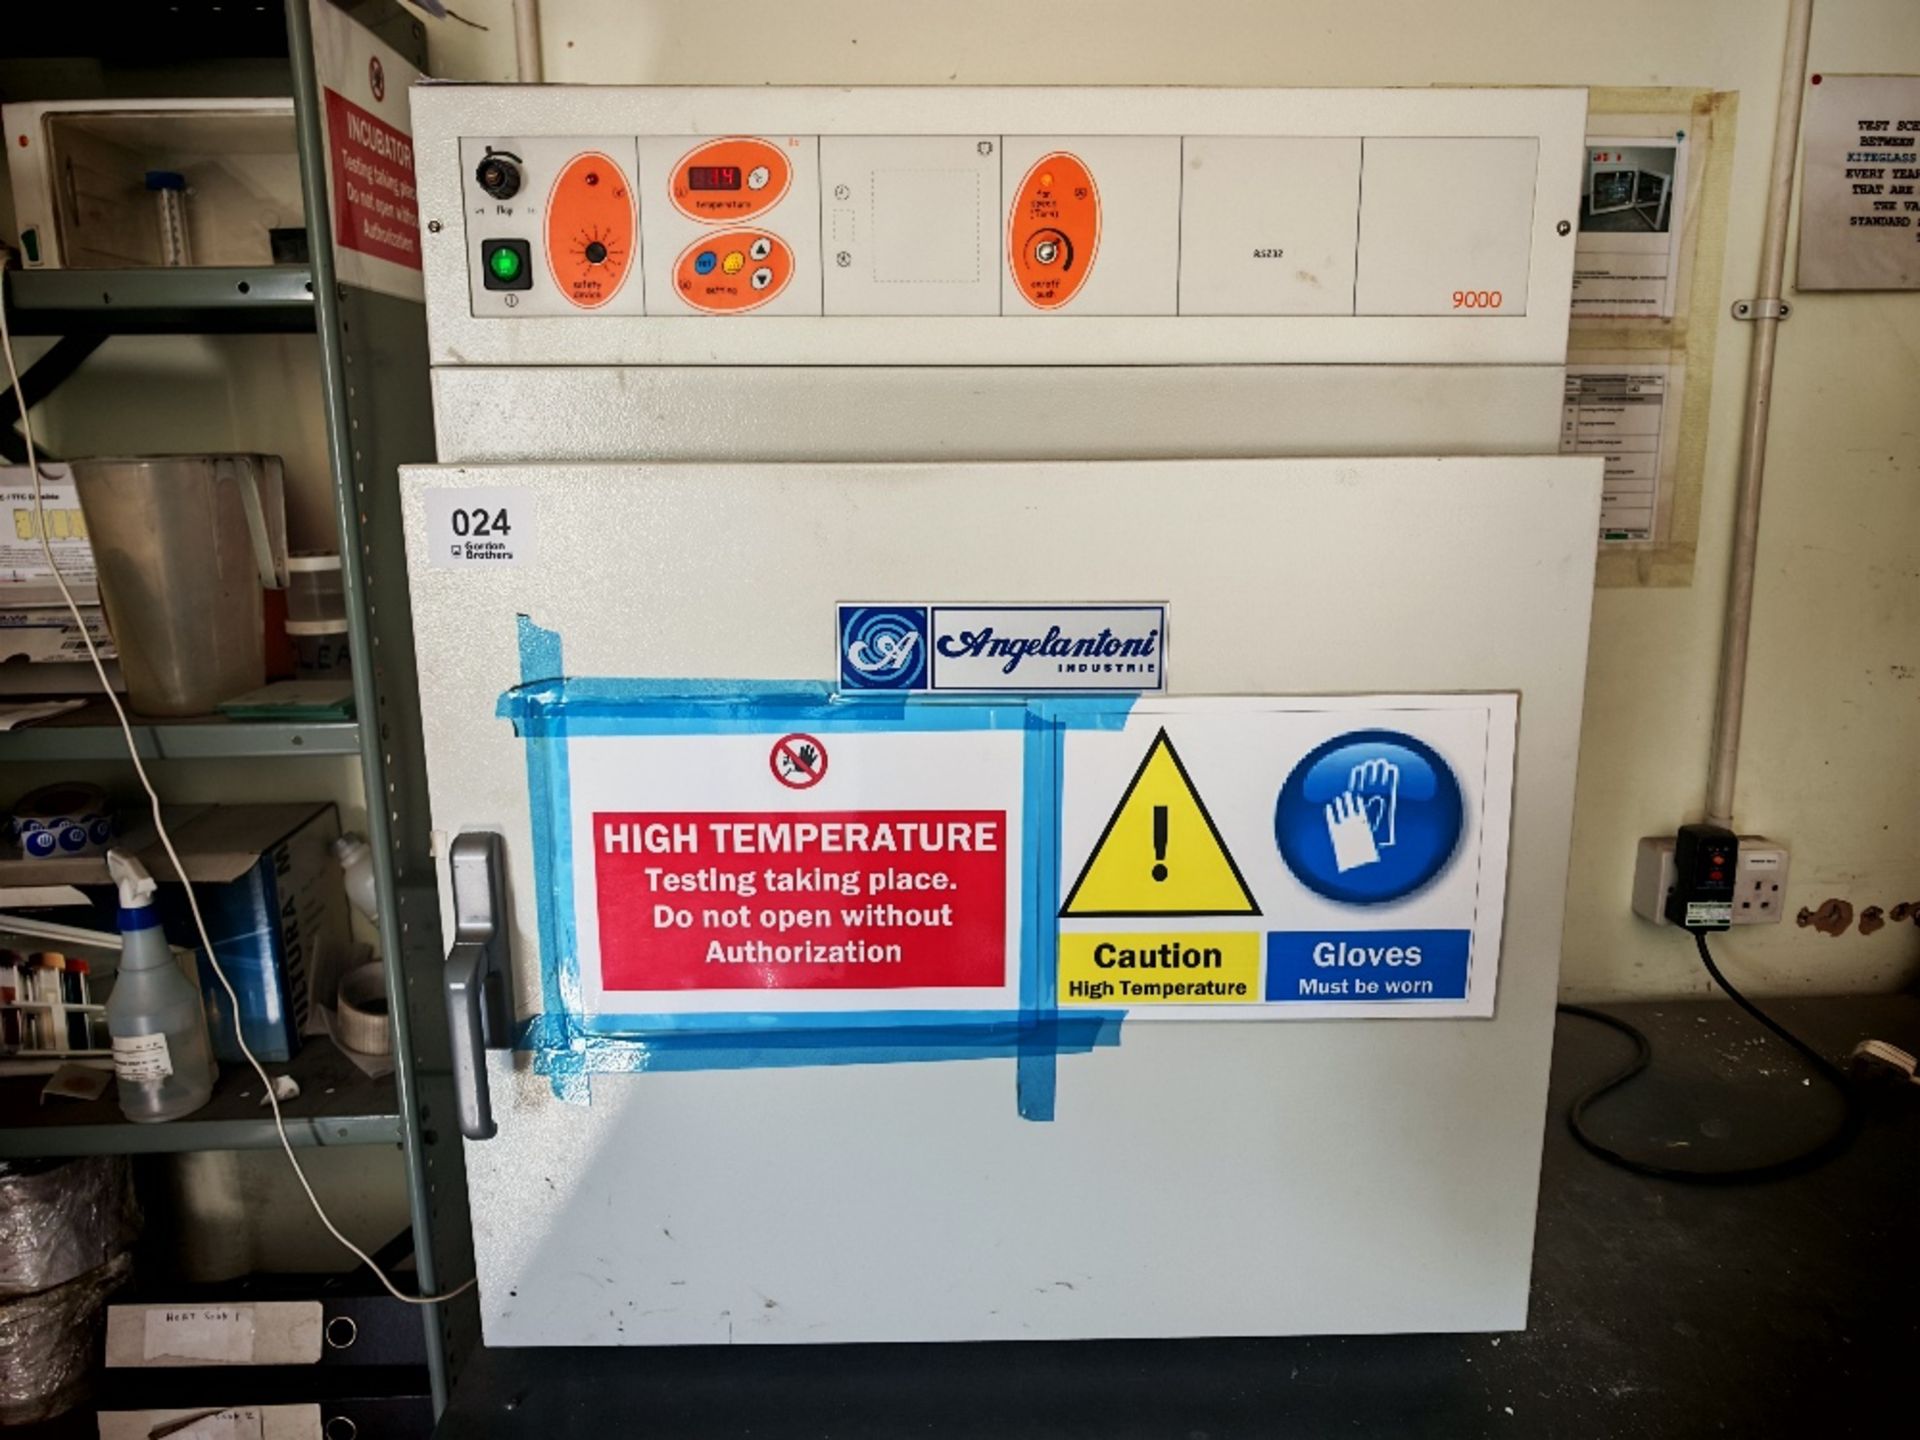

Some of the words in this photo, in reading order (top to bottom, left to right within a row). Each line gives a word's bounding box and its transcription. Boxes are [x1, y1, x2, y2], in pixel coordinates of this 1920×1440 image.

[1858, 120, 1890, 131] TEST
[347, 112, 412, 171] INCUBATOR
[1859, 136, 1915, 147] BETWEEN
[1847, 152, 1917, 163] KITEGLASS
[342, 148, 374, 186] Testing
[373, 164, 399, 197] taking
[1845, 168, 1885, 179] EVERY
[1852, 184, 1884, 195] THAT
[1889, 185, 1914, 195] ARE
[696, 200, 751, 211] temperature
[1850, 216, 1911, 227] STANDARD
[1453, 291, 1502, 308] 9000
[452, 508, 511, 536] 024
[465, 541, 506, 551] Gordon
[466, 550, 513, 560] Brothers
[937, 626, 1159, 675] Angelantoni
[1058, 663, 1155, 673] INDUSTRIE
[603, 823, 698, 854] HIGH
[709, 822, 998, 854] TEMPERATURE
[644, 867, 757, 896] Testing
[764, 867, 861, 896] taking
[869, 867, 958, 895] place.
[653, 904, 694, 929] Do
[702, 906, 751, 929] not
[759, 906, 832, 932] open
[841, 903, 953, 927] without
[705, 940, 902, 964] Authorization
[1094, 942, 1222, 969] Caution
[1312, 941, 1422, 968] Gloves
[1069, 979, 1115, 1000] High
[1119, 979, 1247, 998] Temperature
[1299, 977, 1348, 995] Must
[1354, 977, 1379, 994] be
[1384, 978, 1433, 995] worn
